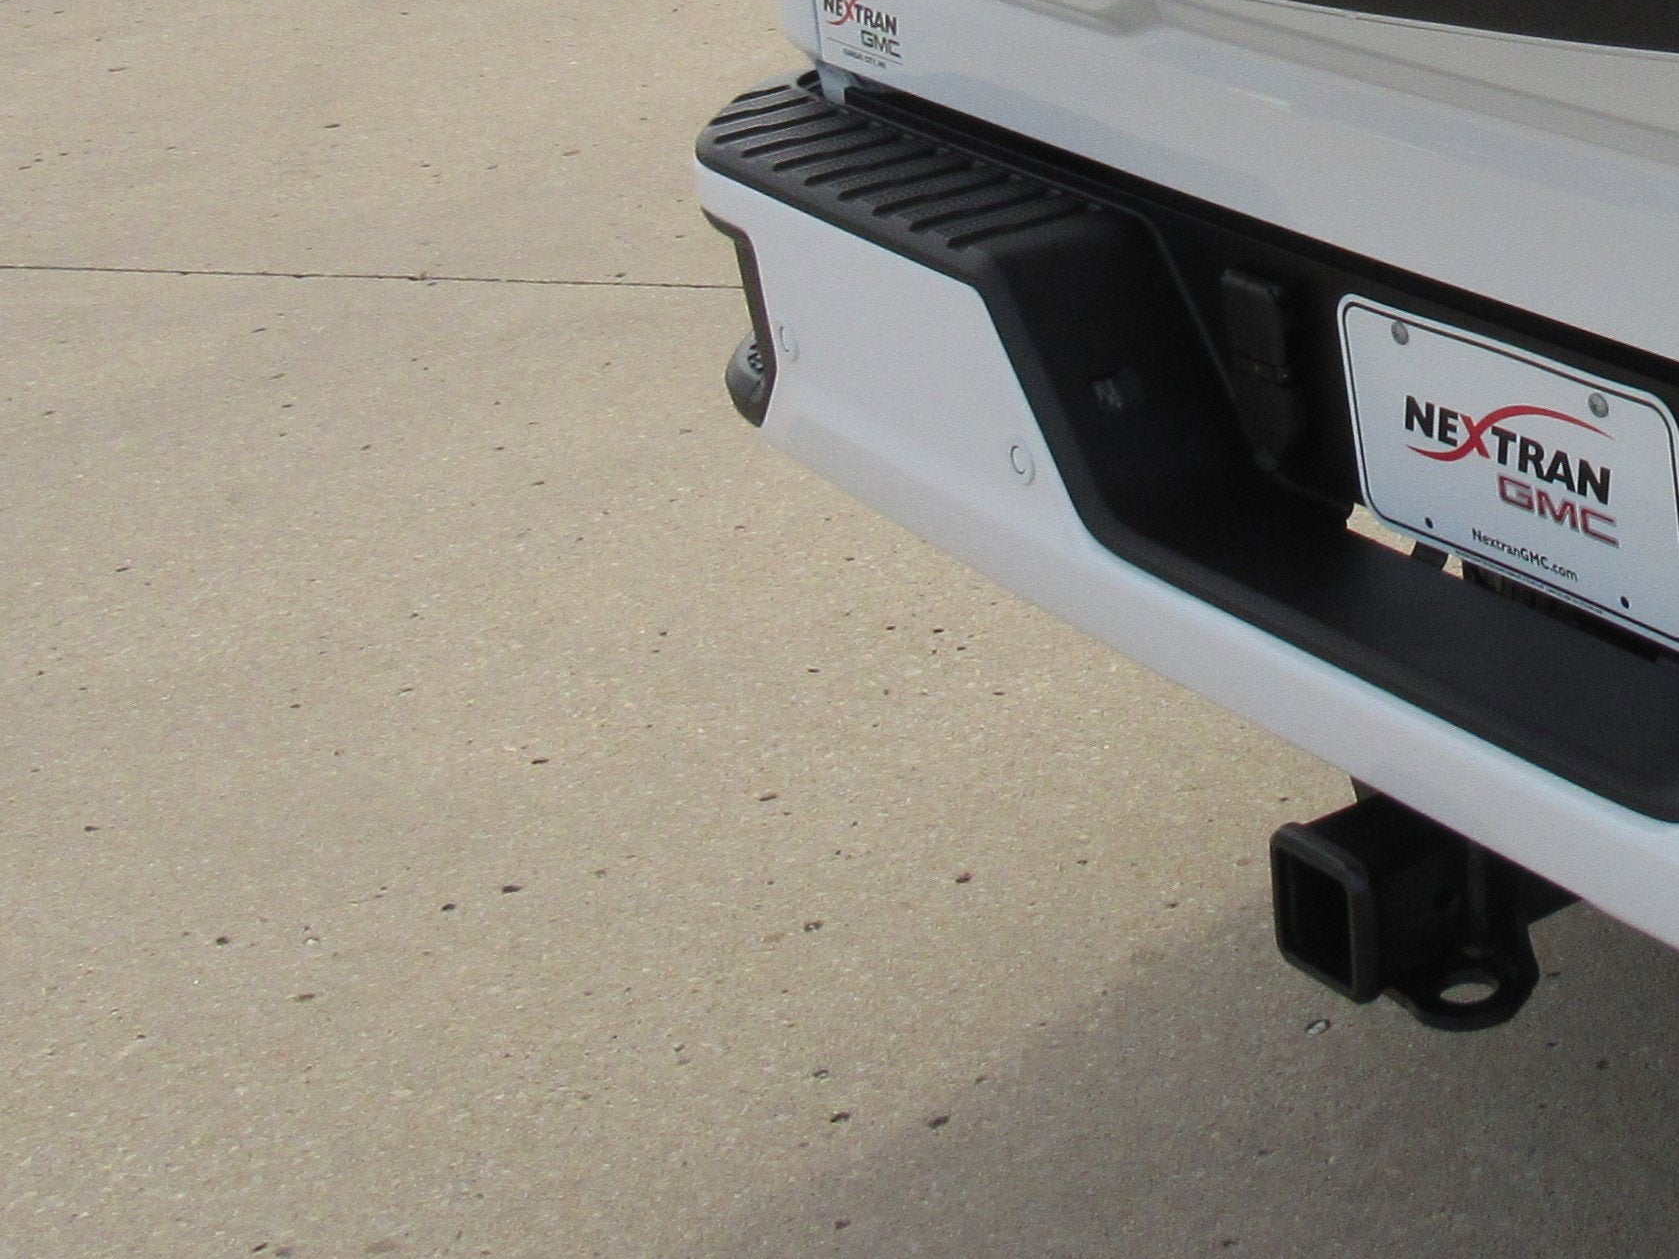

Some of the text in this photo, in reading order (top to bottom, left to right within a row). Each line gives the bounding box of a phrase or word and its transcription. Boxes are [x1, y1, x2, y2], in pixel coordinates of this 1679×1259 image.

[860, 29, 903, 59] GMC
[1404, 394, 1614, 506] NEXTRAN
[1496, 474, 1621, 548] GMC
[1471, 526, 1578, 582] NextranGMC.com
